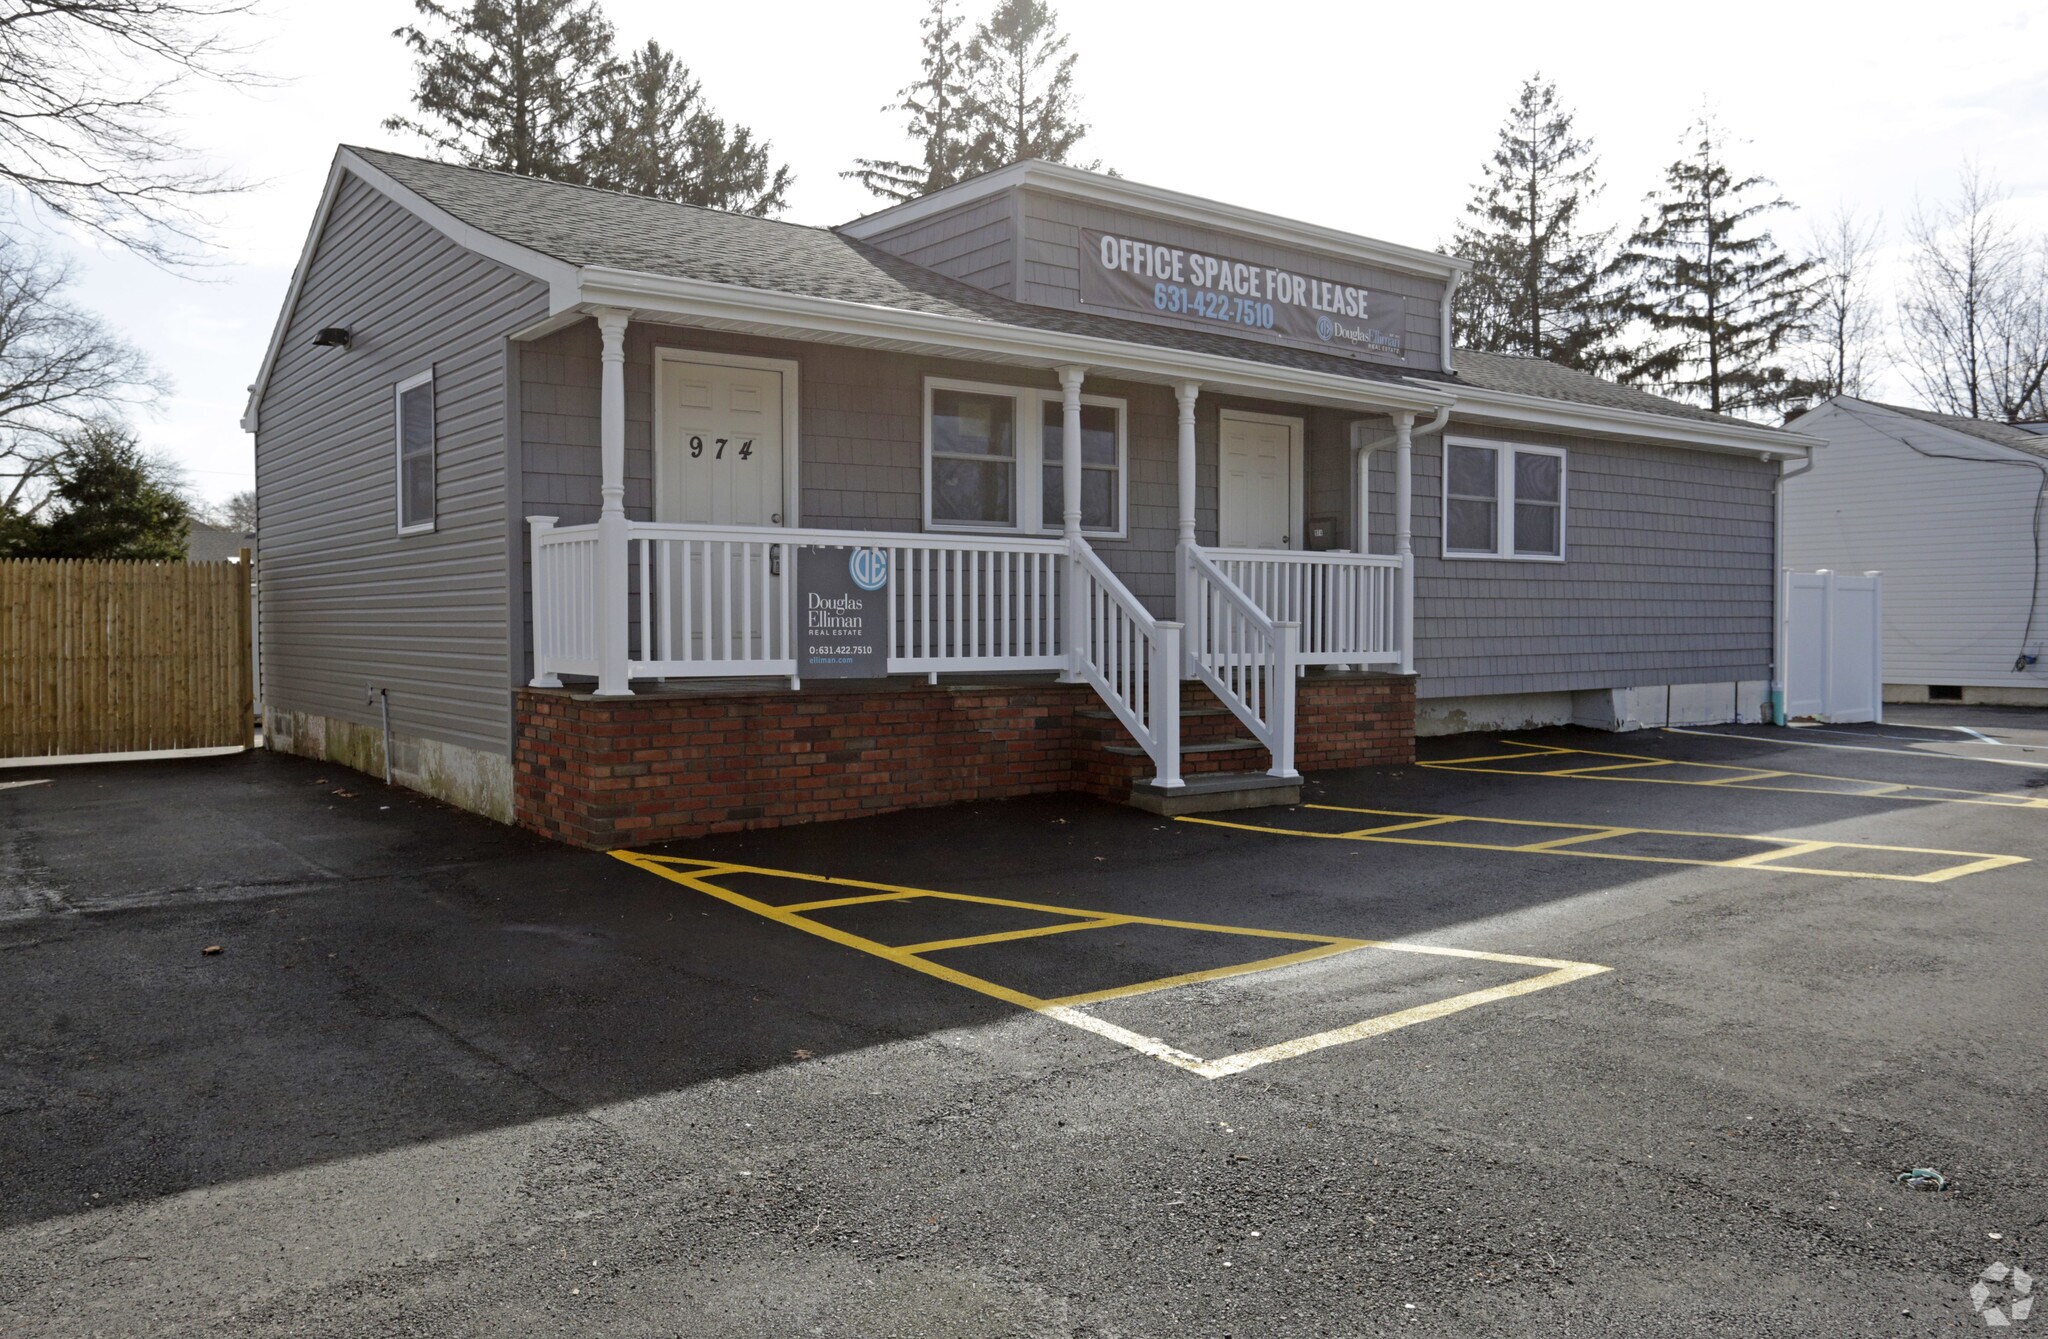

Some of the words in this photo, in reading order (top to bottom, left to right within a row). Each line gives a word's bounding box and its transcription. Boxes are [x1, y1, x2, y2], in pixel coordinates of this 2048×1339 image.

[1100, 235, 1184, 282] OFFICE
[1190, 253, 1261, 297] SPACE
[1266, 268, 1307, 307] FOR
[1312, 279, 1369, 319] LEASE
[1154, 282, 1274, 329] 631-422-7510
[689, 436, 753, 460] 974
[808, 592, 863, 615] Douglas
[808, 610, 862, 628] Elliman
[809, 656, 853, 664] elliman.com
